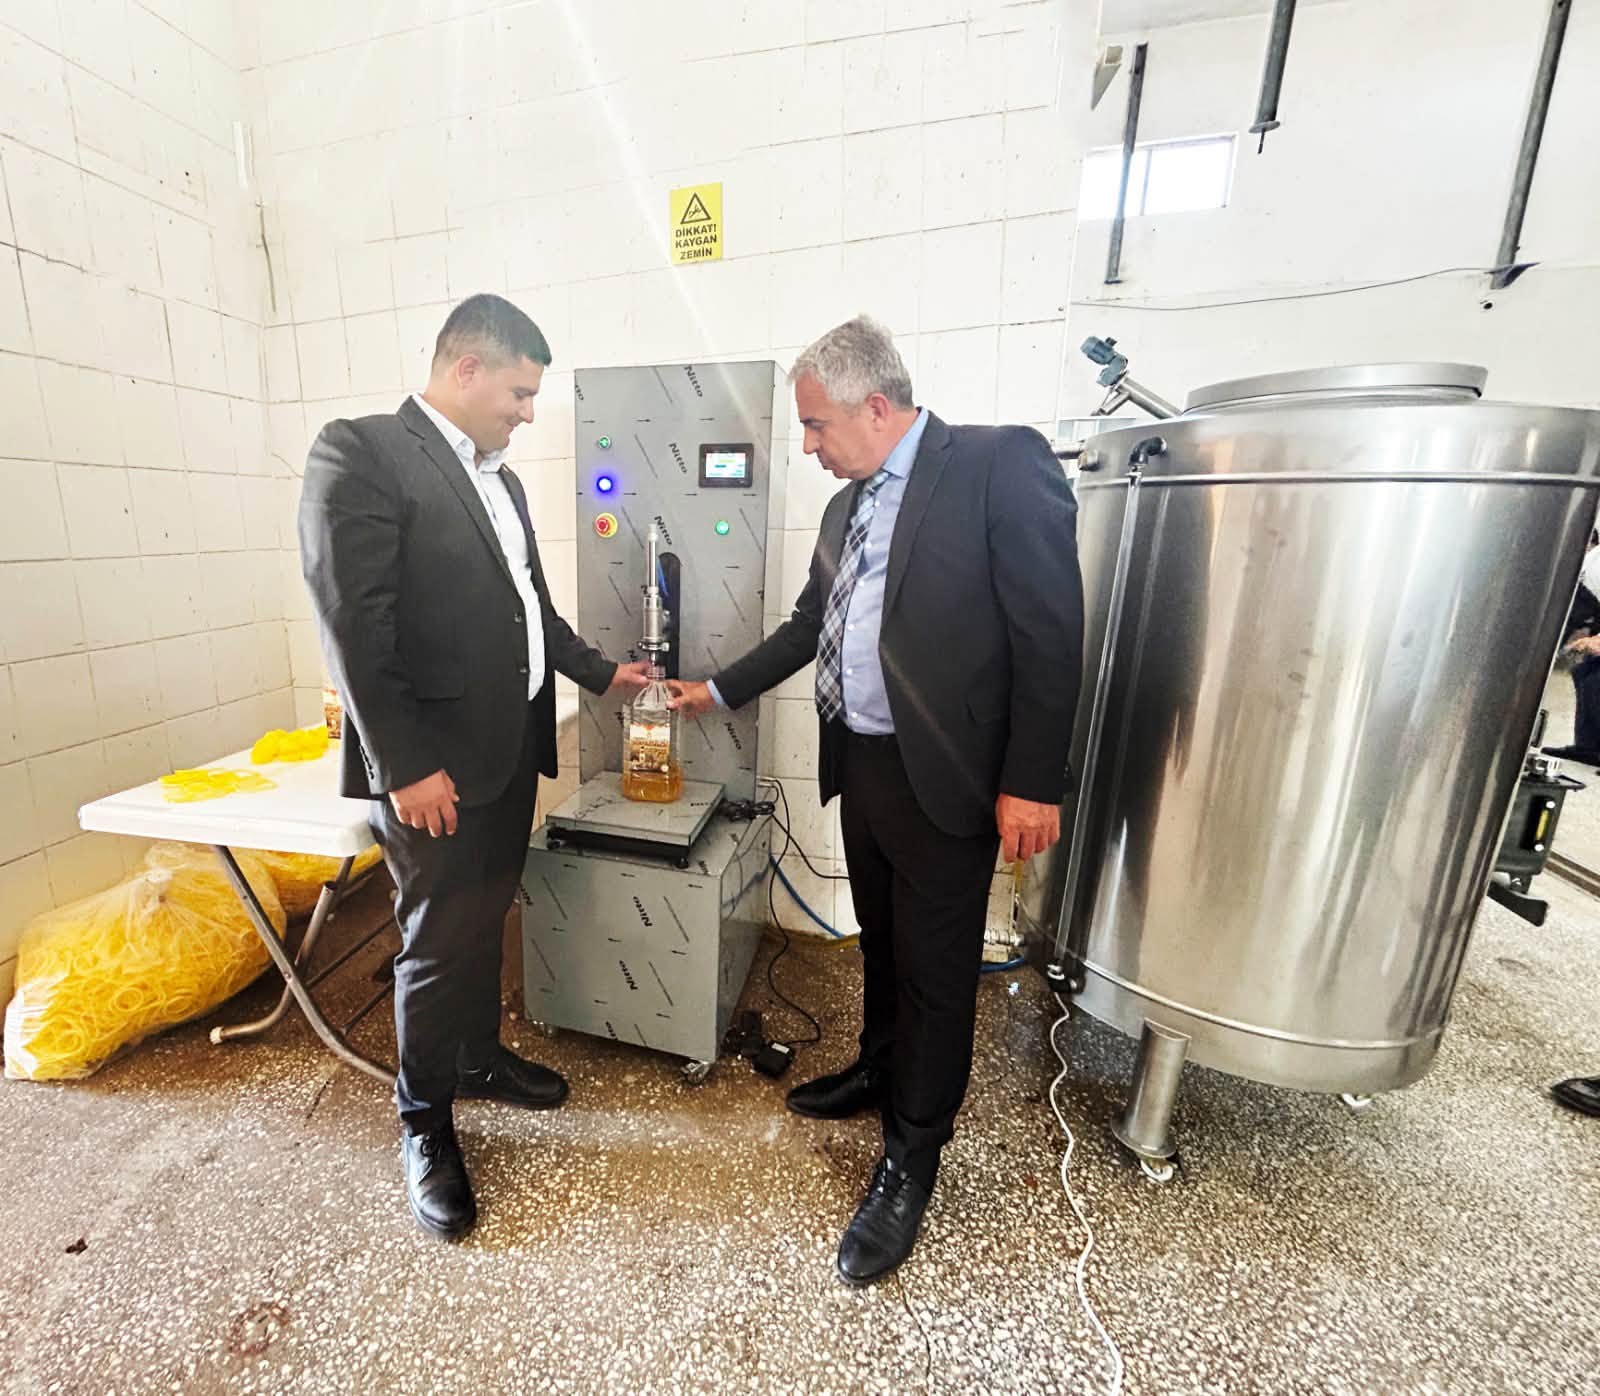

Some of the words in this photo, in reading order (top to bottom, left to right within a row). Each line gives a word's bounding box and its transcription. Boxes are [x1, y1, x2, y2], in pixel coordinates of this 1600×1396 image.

[675, 223, 717, 238] DİKKAT!
[675, 234, 717, 248] KAYGAN
[680, 247, 712, 260] ZEMİN
[684, 365, 703, 397] Nitto
[668, 442, 687, 475] Nitto
[654, 515, 673, 546] Nitto
[724, 722, 742, 750] Nitto
[633, 896, 653, 927] Nitto
[619, 960, 638, 991] Nitto
